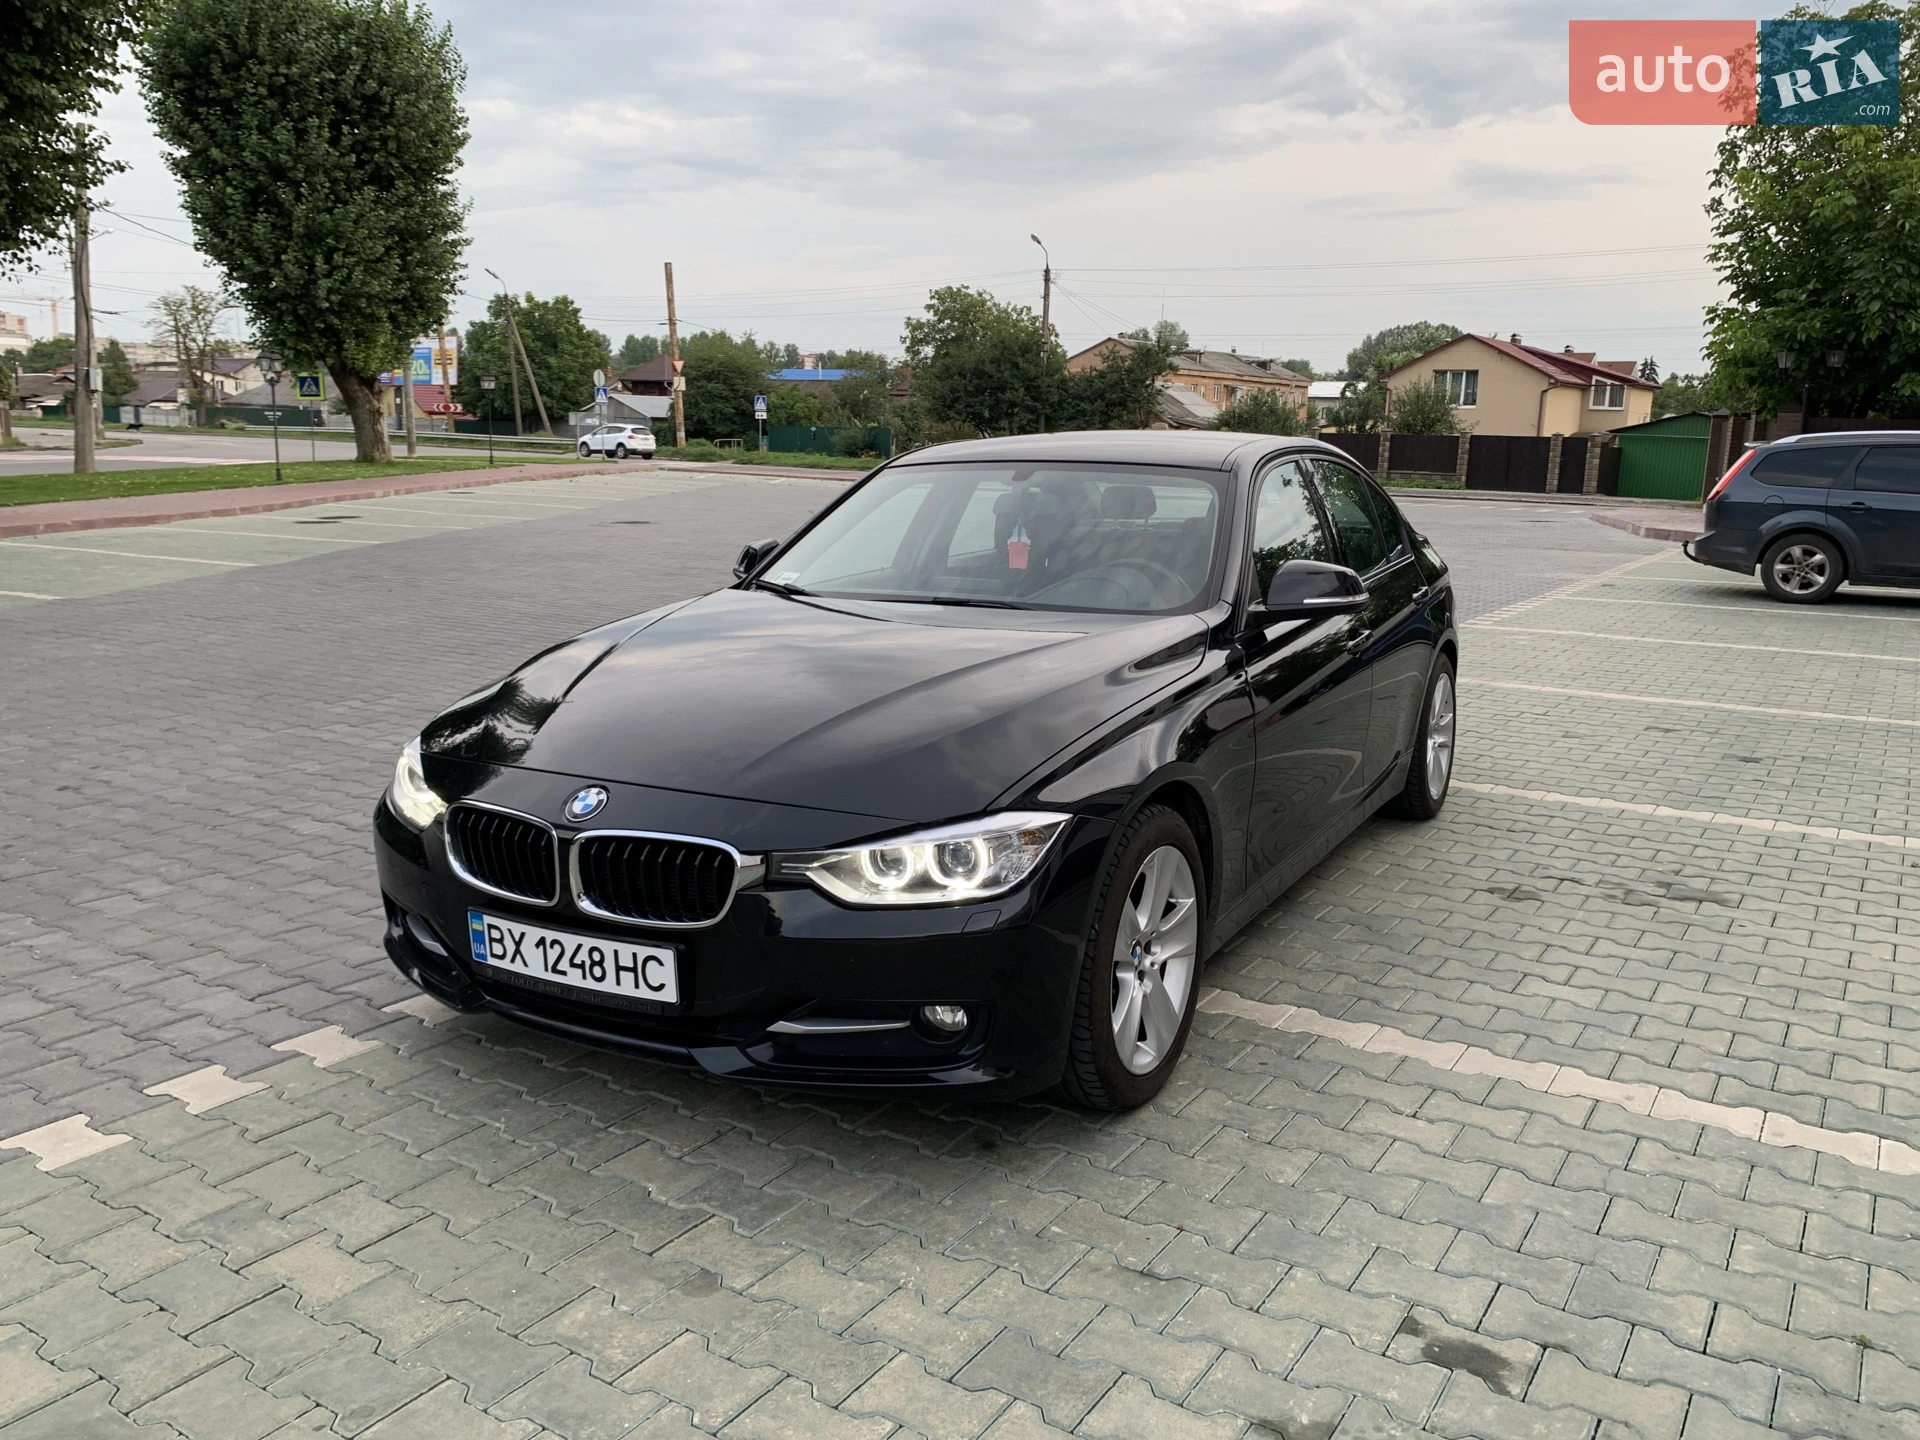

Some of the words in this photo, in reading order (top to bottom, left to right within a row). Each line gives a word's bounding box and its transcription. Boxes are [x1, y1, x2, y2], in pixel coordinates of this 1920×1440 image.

[473, 942, 486, 955] UA
[486, 922, 529, 968] BX
[534, 935, 607, 983] 1248
[613, 948, 667, 993] HC
